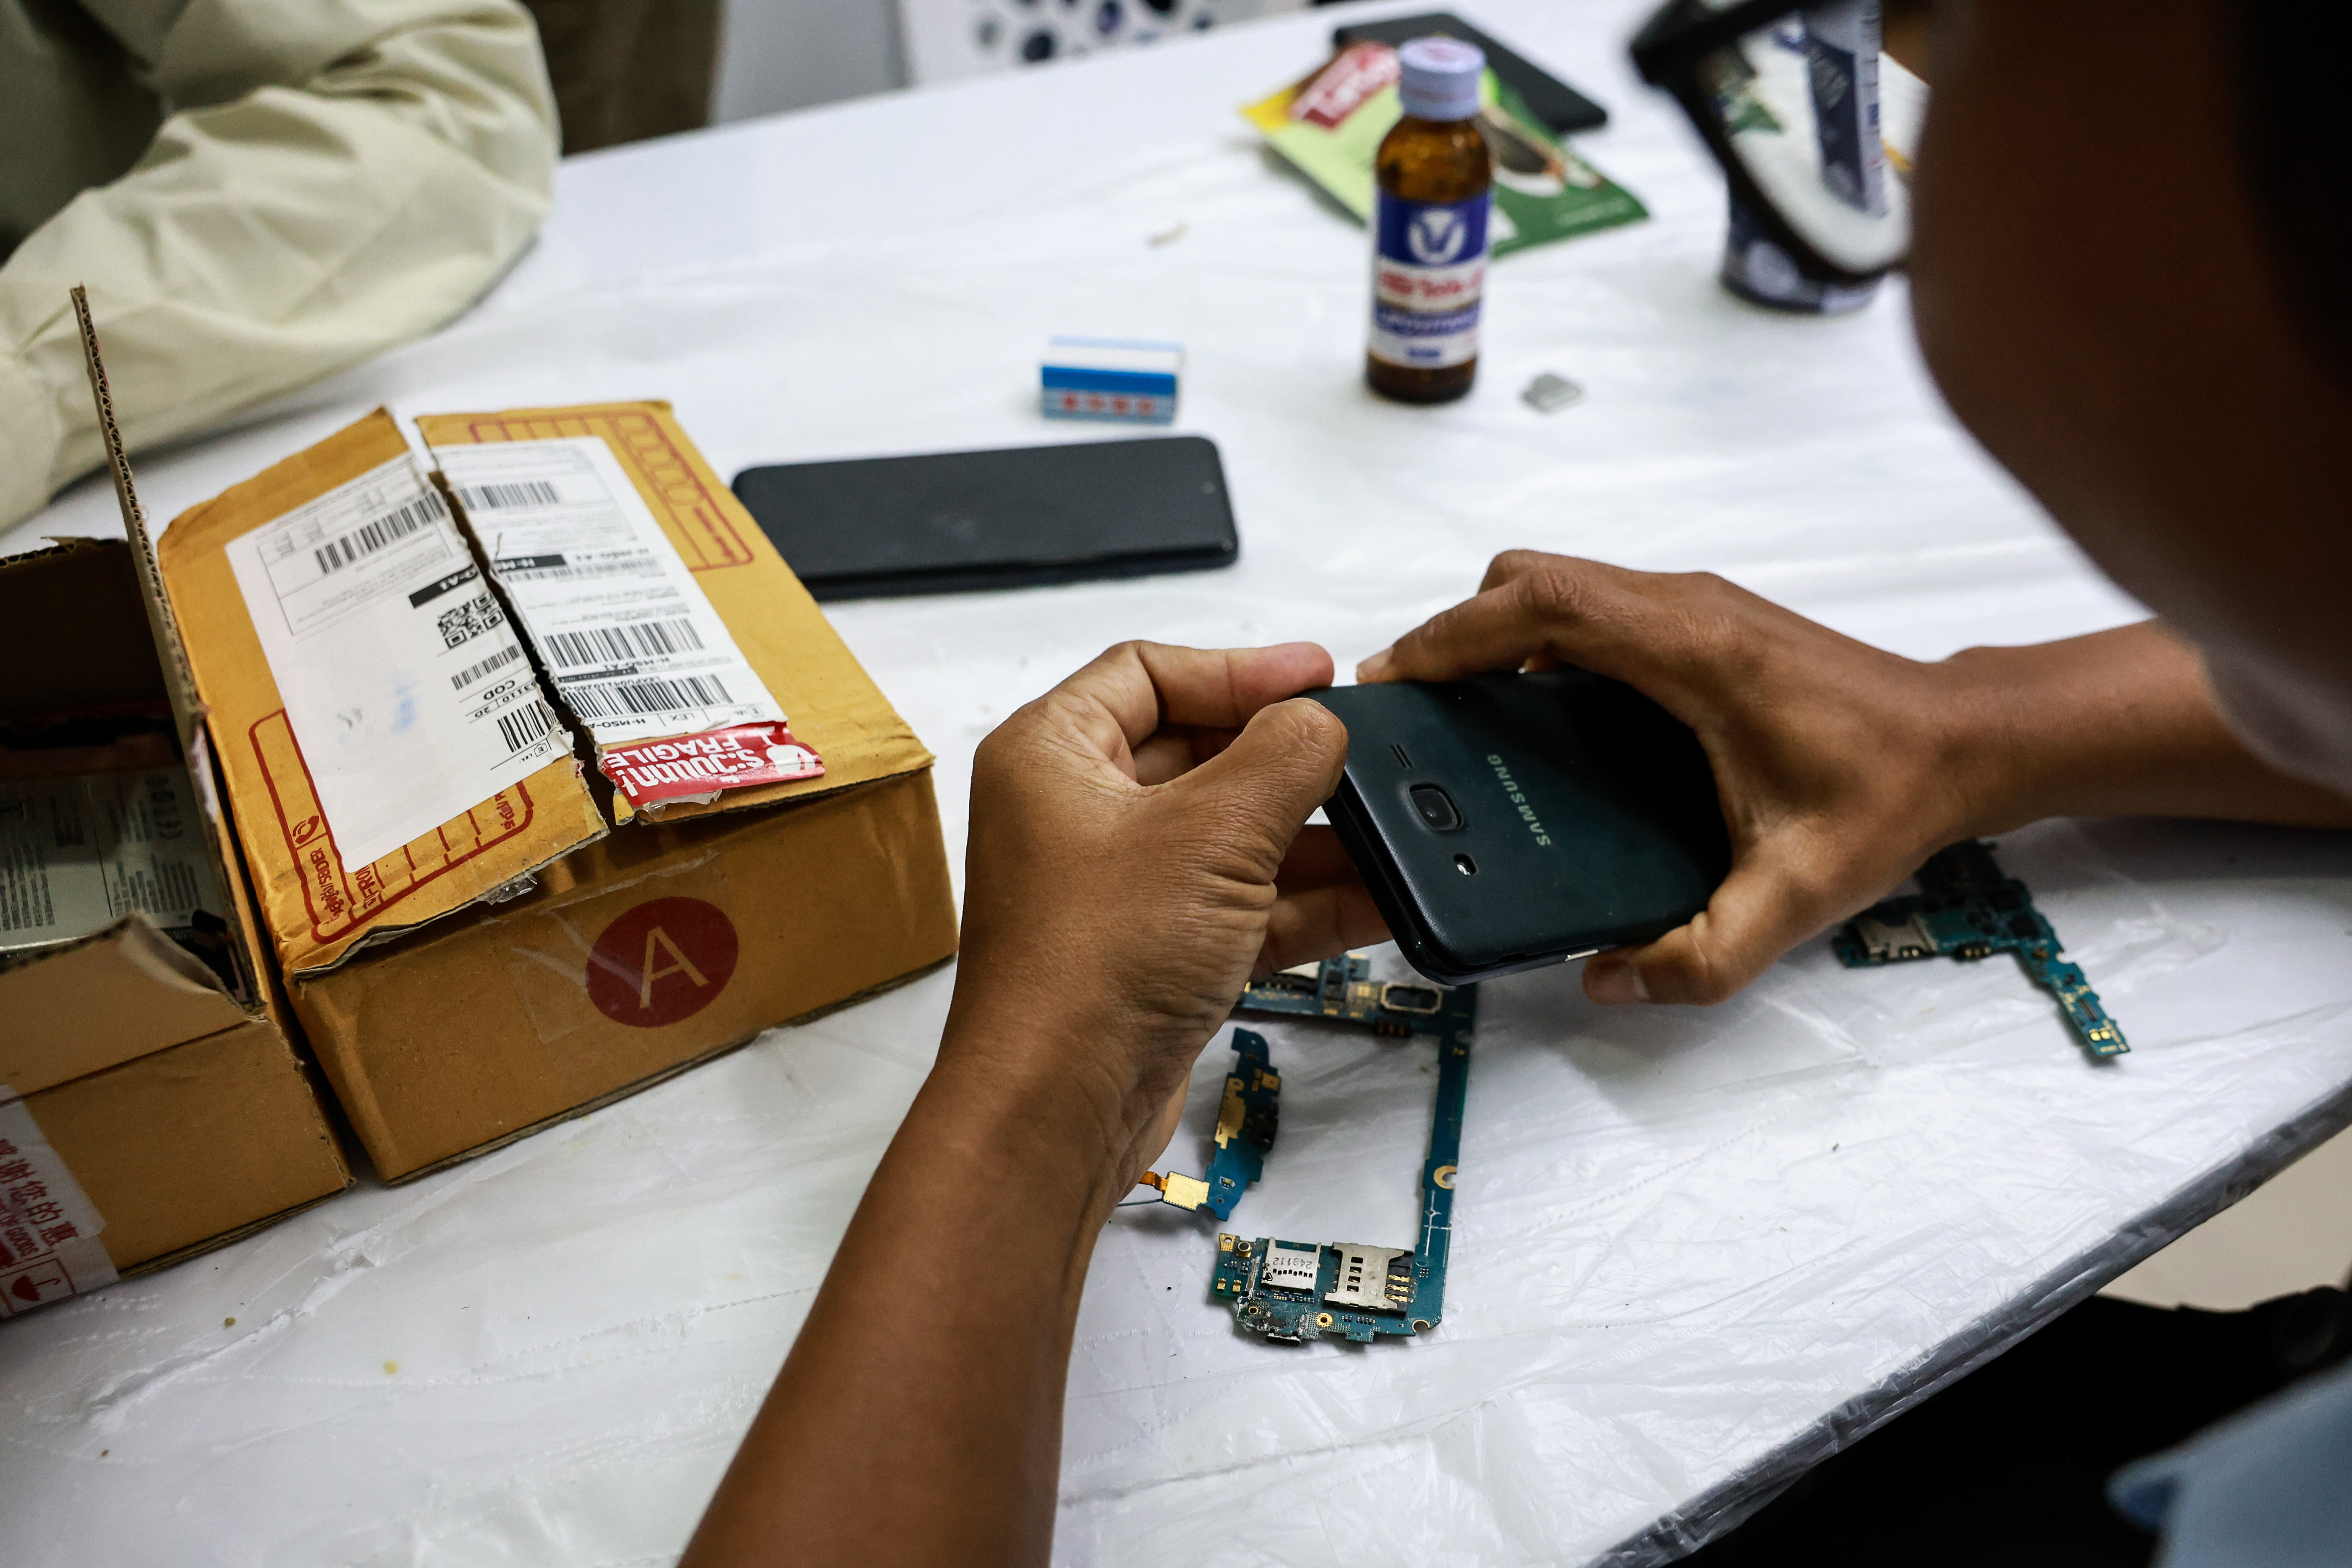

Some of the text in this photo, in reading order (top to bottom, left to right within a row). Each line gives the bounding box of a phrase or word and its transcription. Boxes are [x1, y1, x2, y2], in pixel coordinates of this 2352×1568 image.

[483, 680, 515, 700] COD
[474, 706, 490, 718] 2D
[669, 712, 696, 721] LEX
[603, 734, 743, 769] FRAGILE
[1487, 754, 1551, 846] SAMSUNG
[639, 926, 709, 1010] A
[5, 1227, 40, 1257] GOODS
